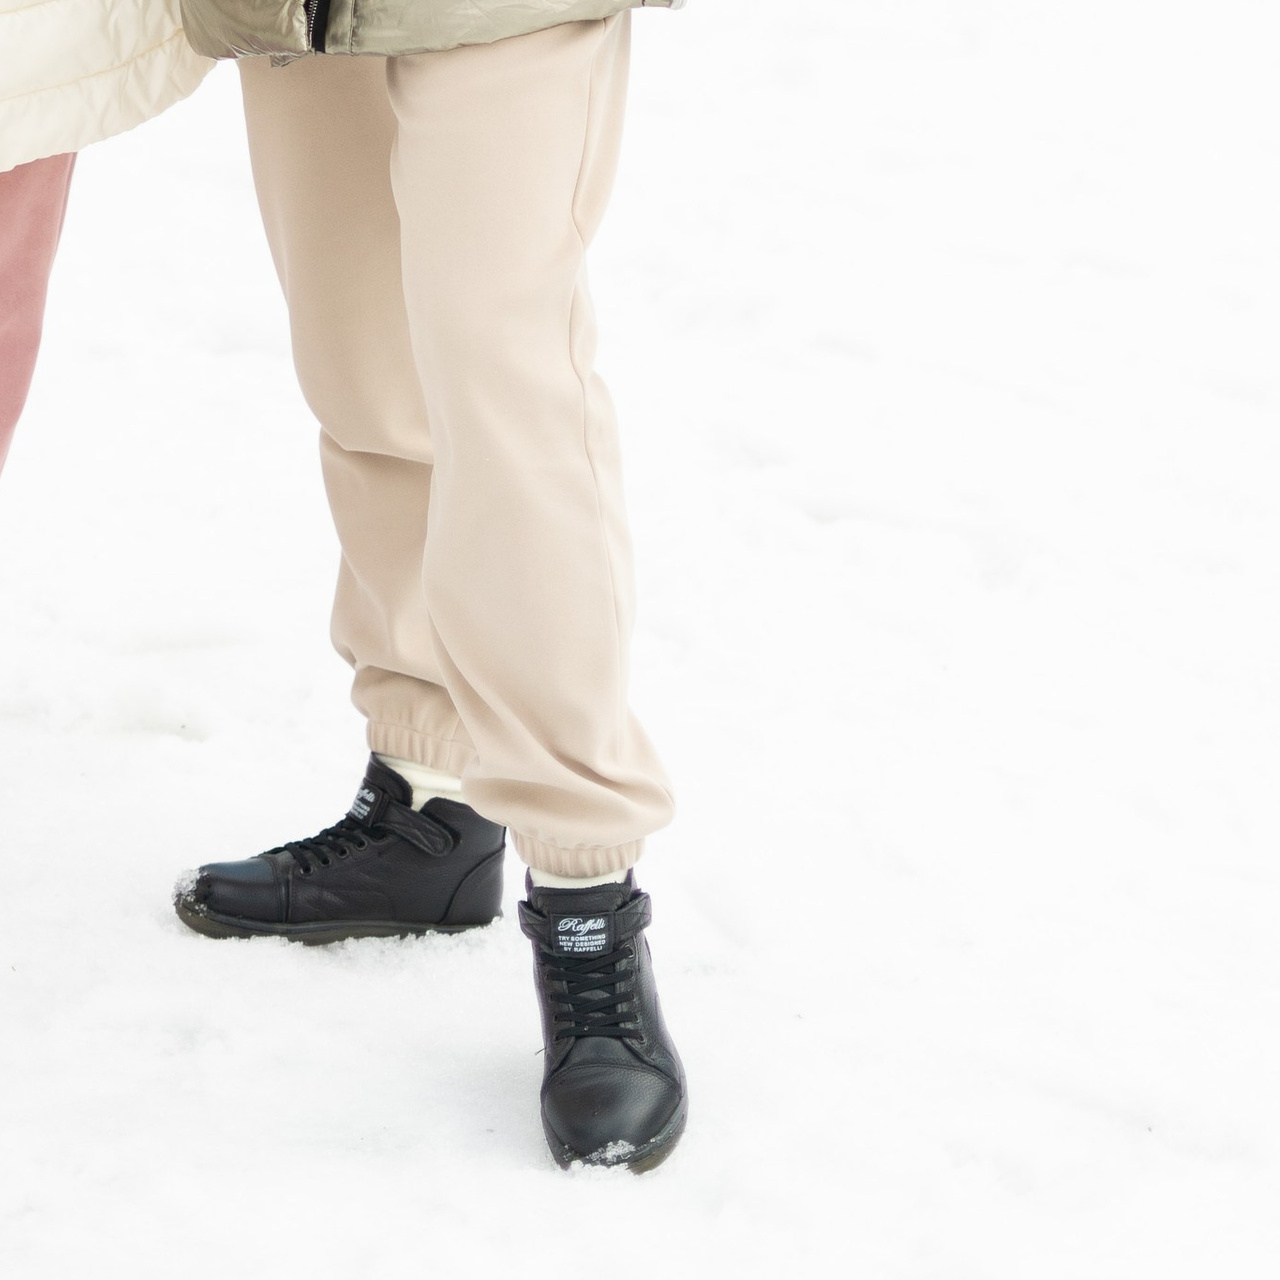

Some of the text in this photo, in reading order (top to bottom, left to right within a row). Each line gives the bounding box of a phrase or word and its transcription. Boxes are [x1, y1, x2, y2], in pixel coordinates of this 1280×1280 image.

[557, 917, 606, 935] Raffelli
[570, 934, 606, 942] SOMETHING
[575, 939, 606, 947] DESIGNED
